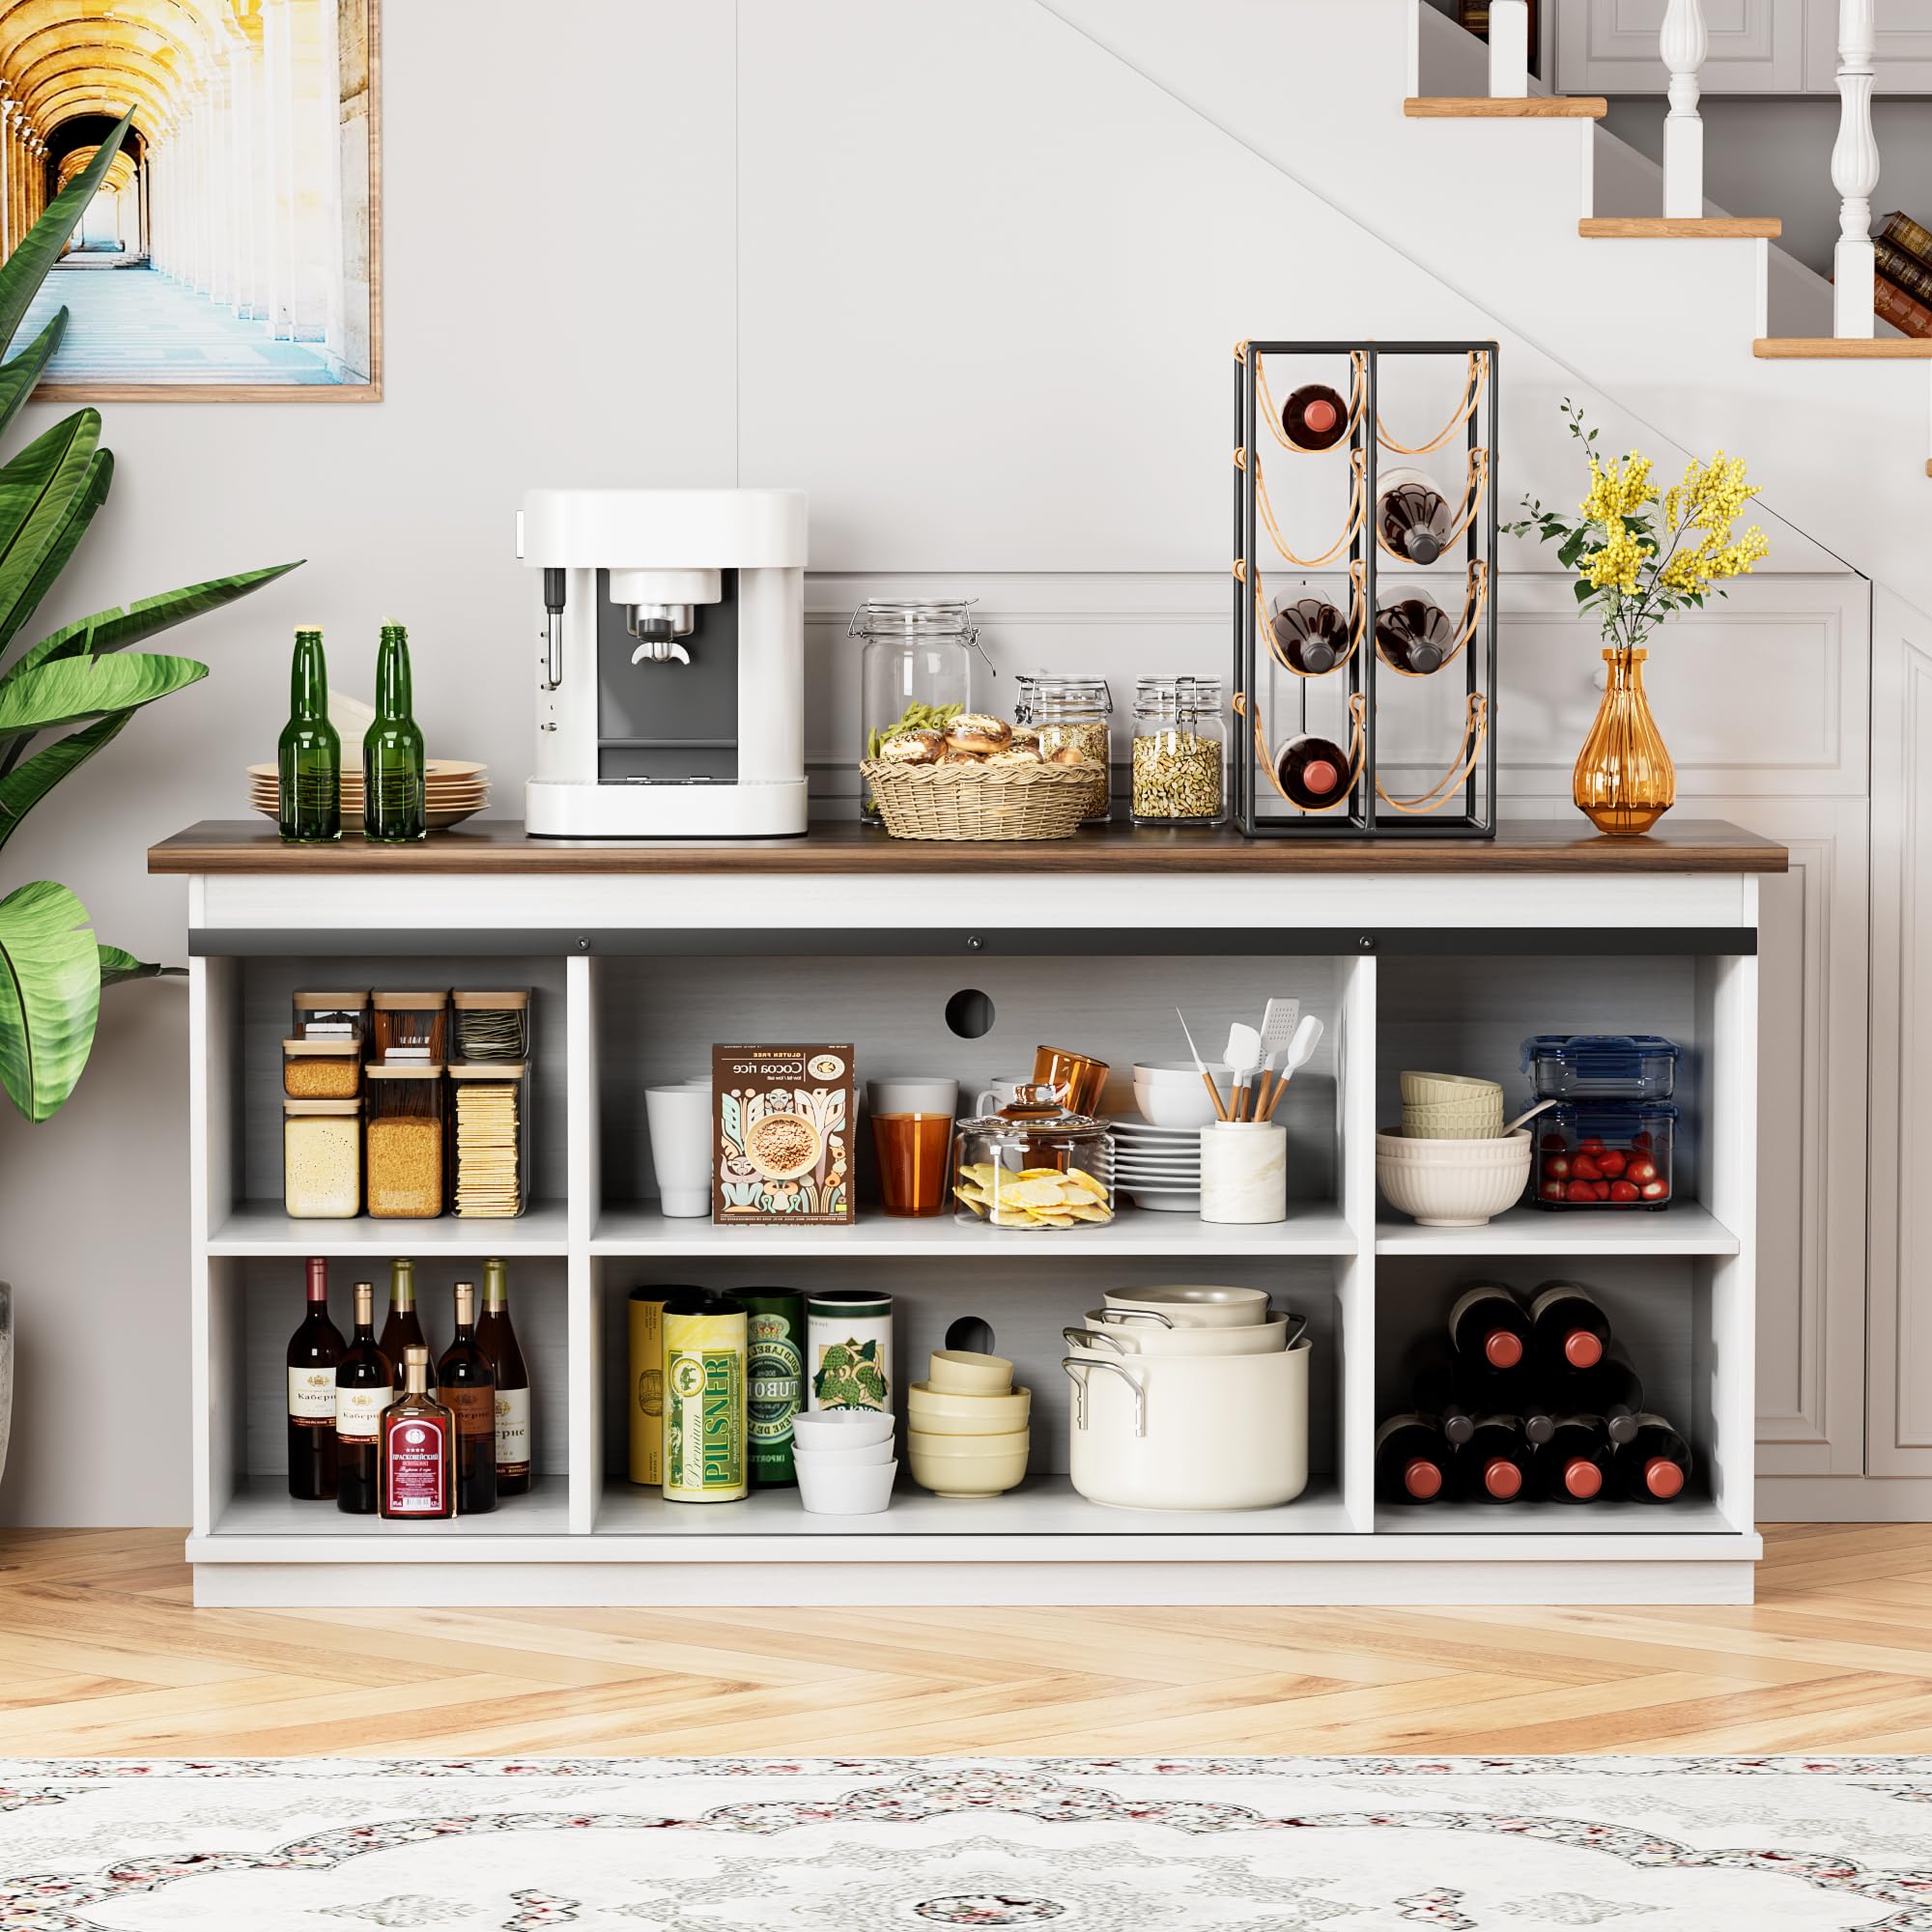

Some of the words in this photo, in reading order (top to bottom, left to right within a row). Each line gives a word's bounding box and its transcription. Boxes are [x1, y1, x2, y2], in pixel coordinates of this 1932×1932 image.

[297, 1392, 336, 1402] Каберн
[702, 1358, 730, 1483] PILSNER
[684, 1414, 702, 1488] Premium
